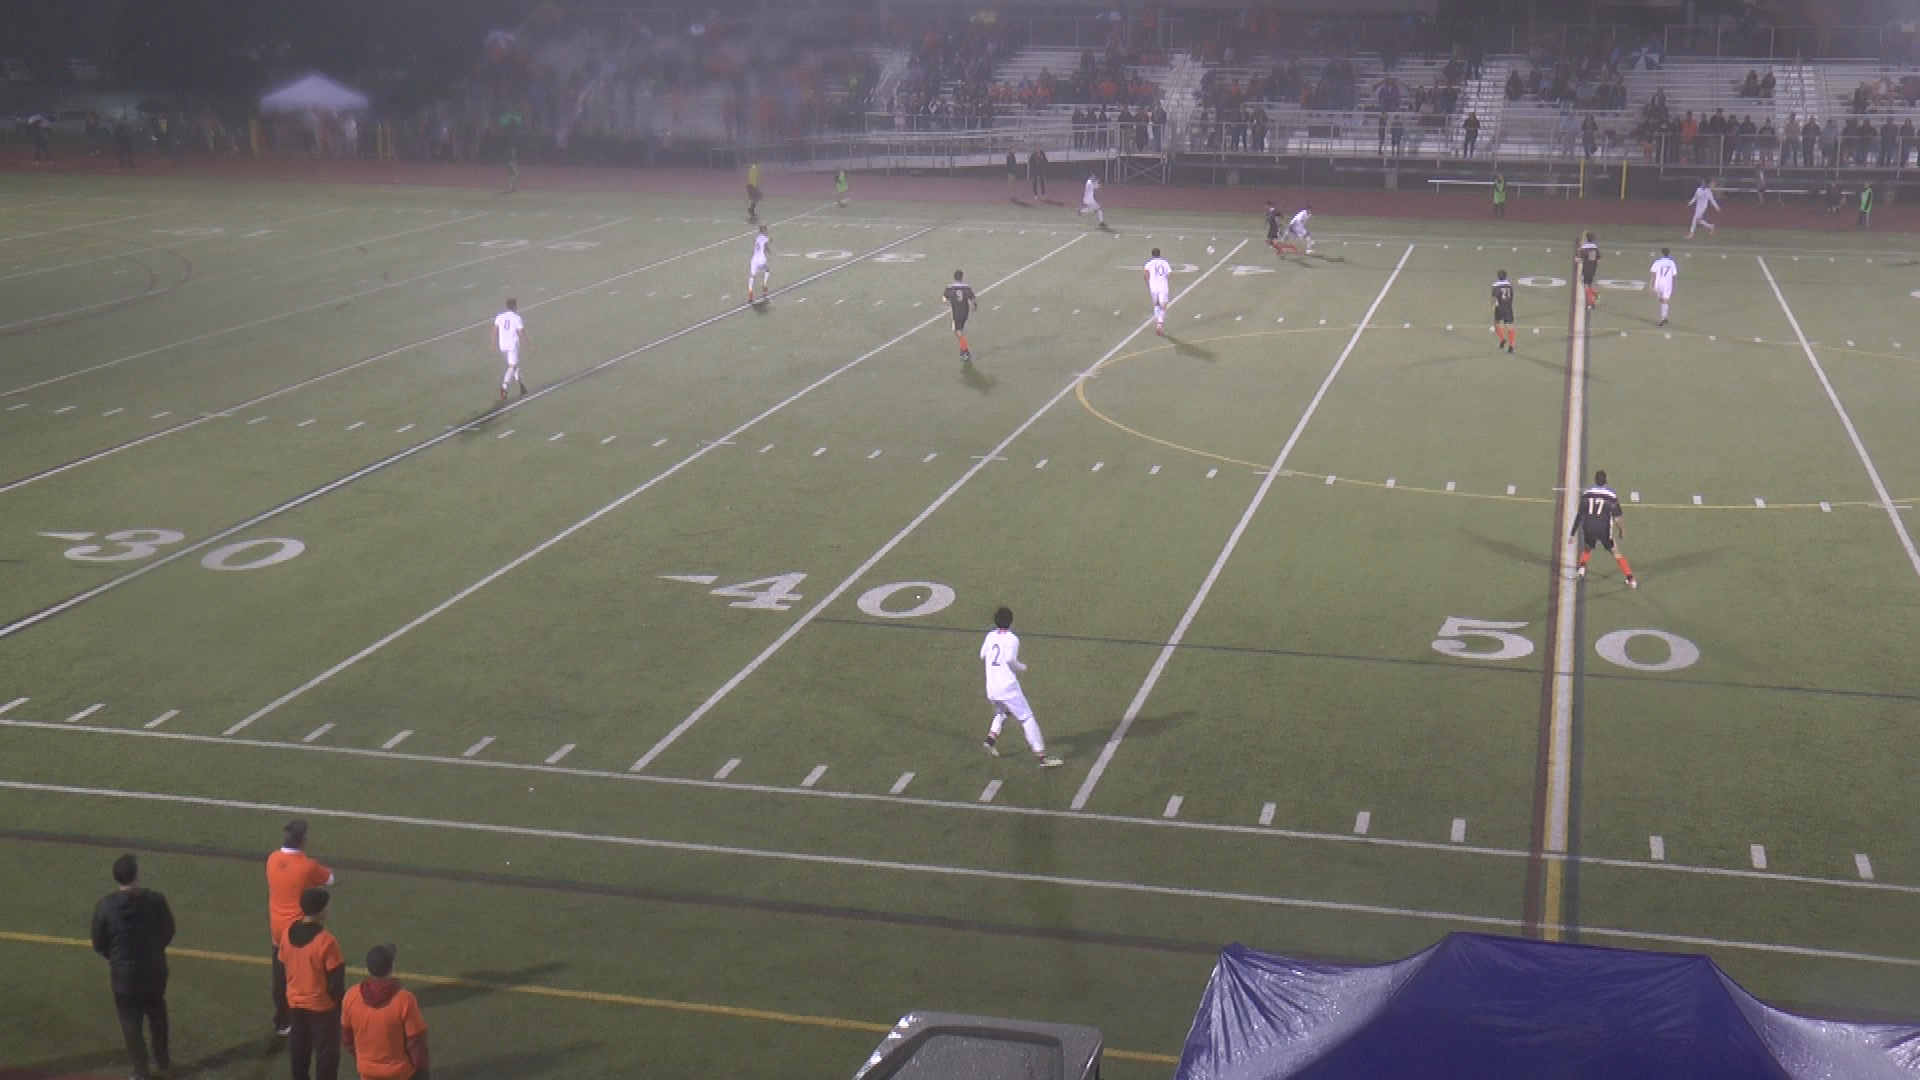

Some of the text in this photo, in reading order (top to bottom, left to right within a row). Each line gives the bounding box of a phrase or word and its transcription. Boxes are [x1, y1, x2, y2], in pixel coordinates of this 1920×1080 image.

[1154, 265, 1165, 277] 10
[1659, 265, 1671, 277] 17
[955, 289, 964, 301] 9
[1501, 287, 1511, 299] 21
[1588, 497, 1605, 515] 17
[991, 643, 1001, 667] 2
